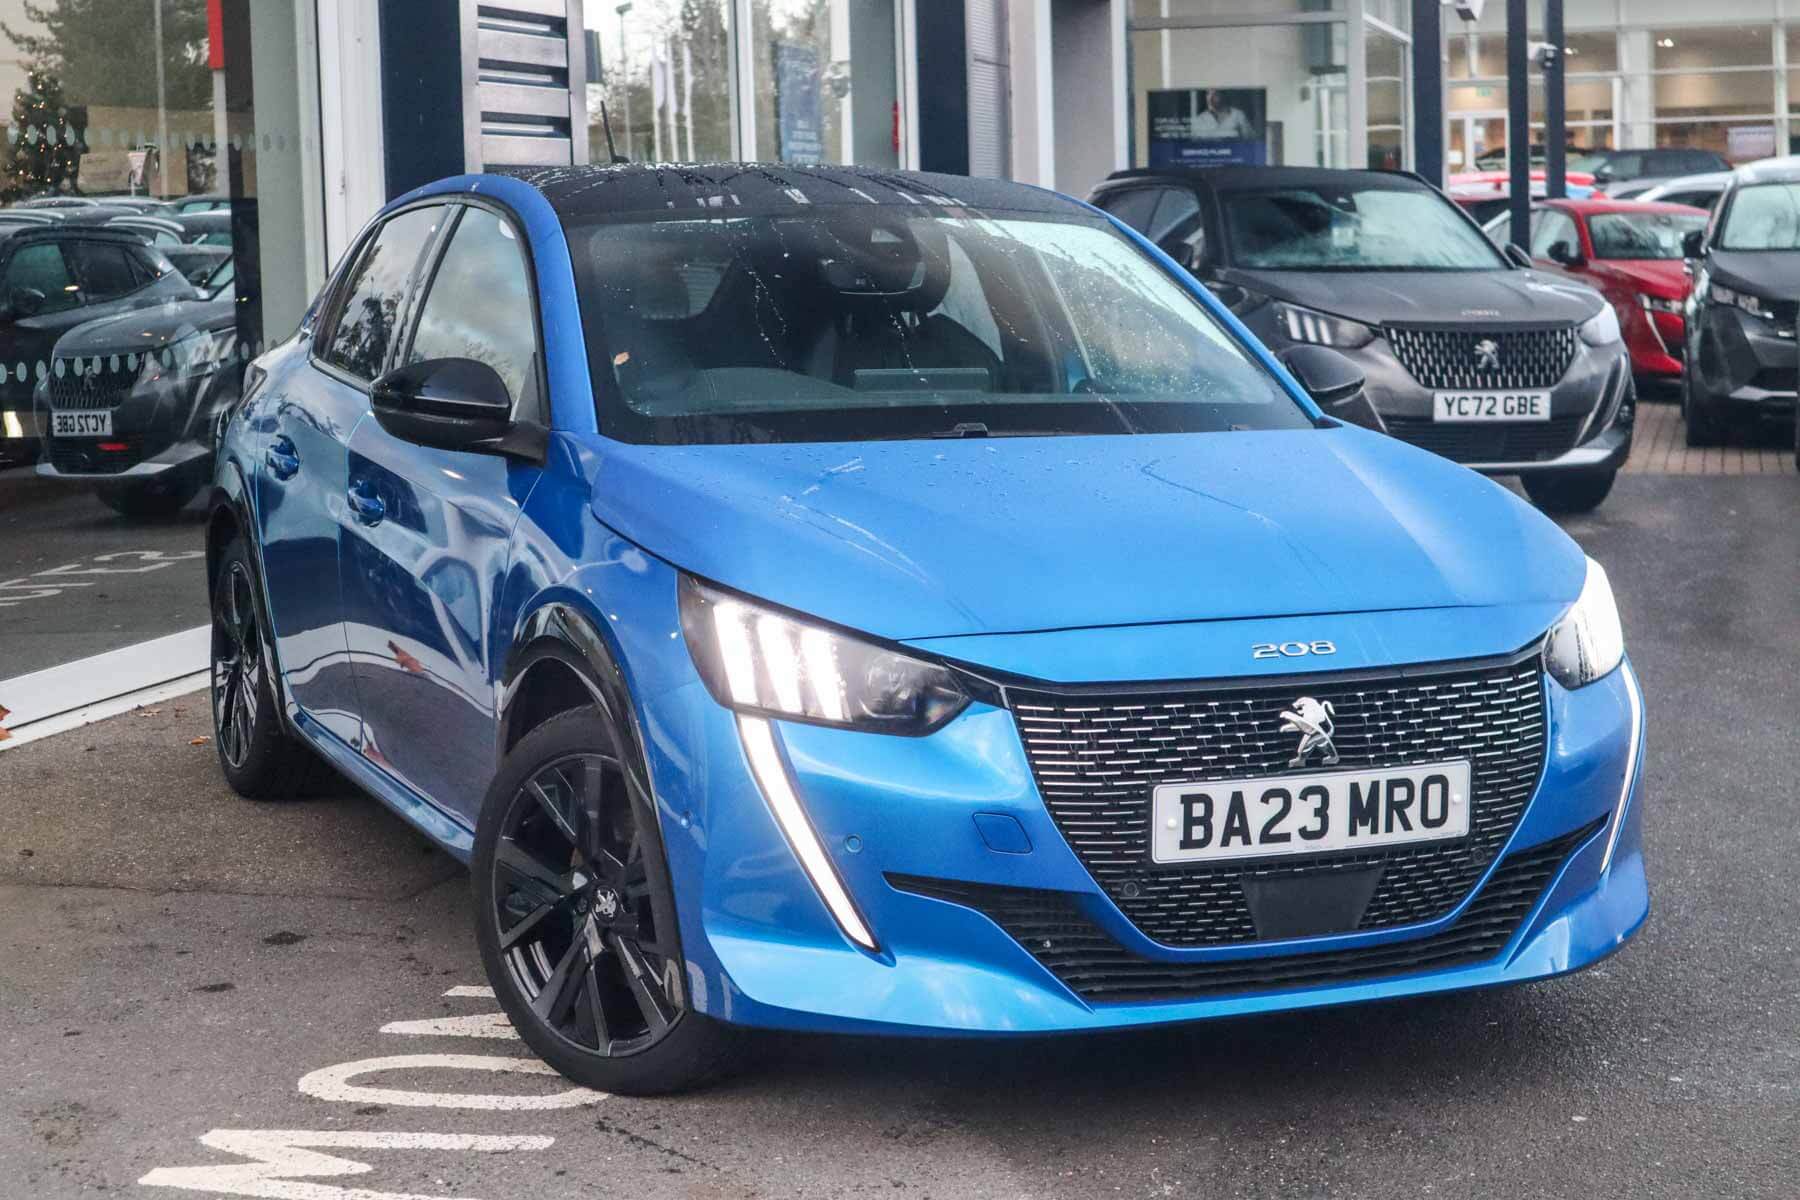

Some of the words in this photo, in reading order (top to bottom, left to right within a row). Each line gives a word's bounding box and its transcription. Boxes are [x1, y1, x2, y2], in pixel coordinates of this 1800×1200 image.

[1443, 395, 1498, 416] YC72
[1503, 395, 1542, 416] GBE
[1251, 640, 1336, 660] 208
[1179, 784, 1330, 850] BA23
[1348, 773, 1450, 837] MRO
